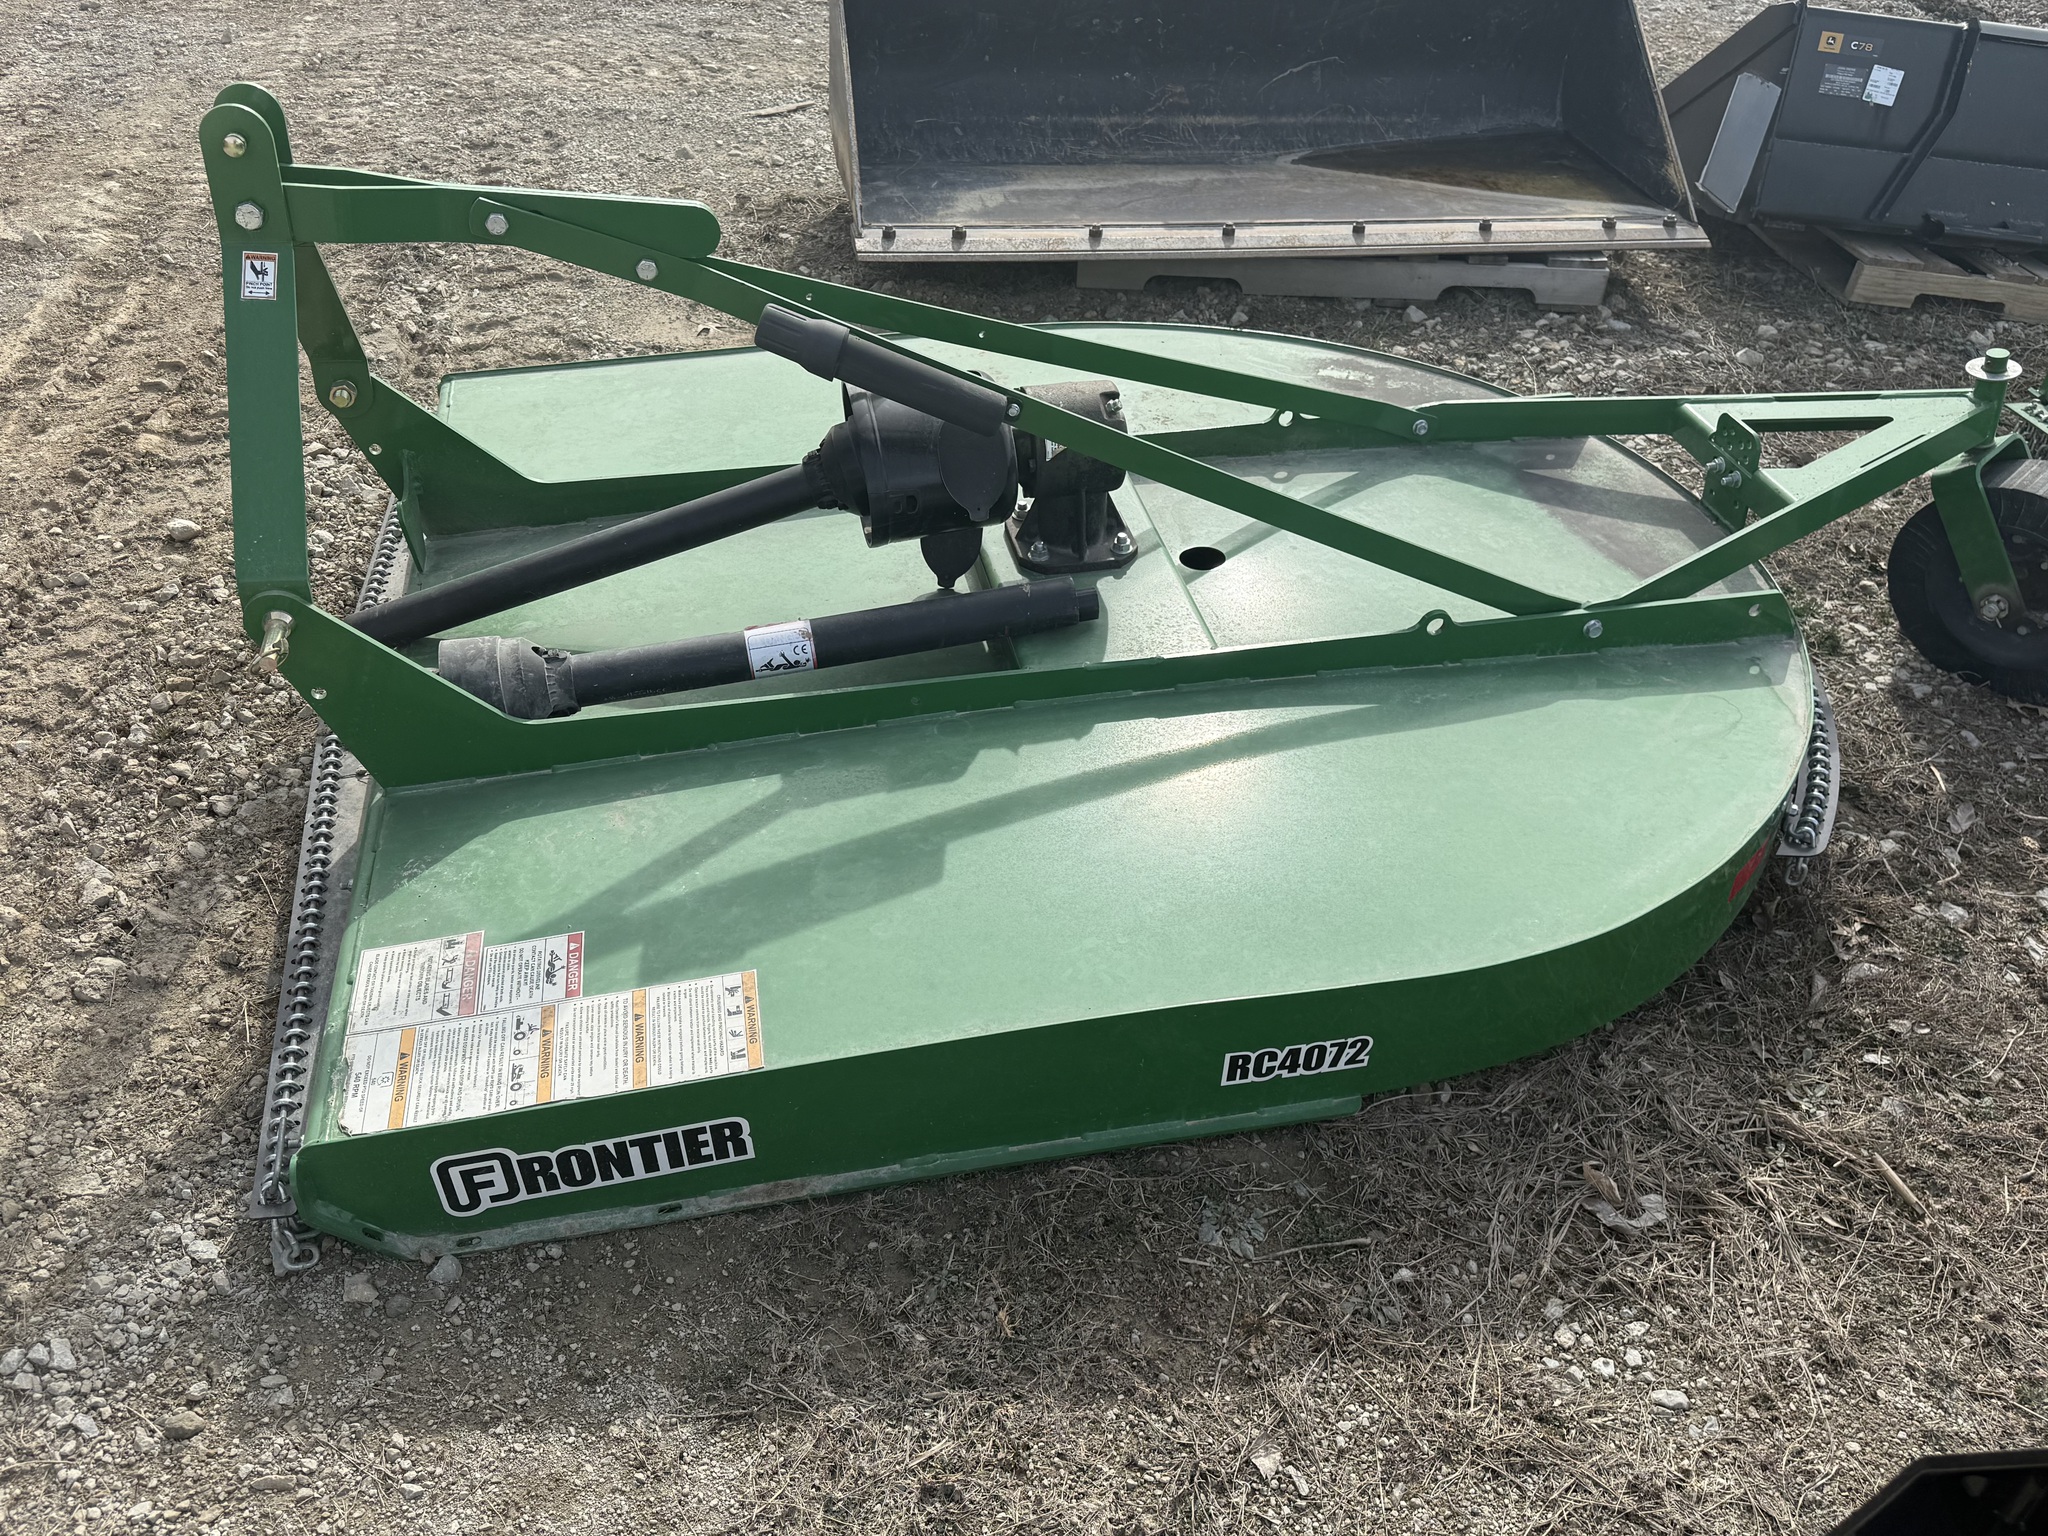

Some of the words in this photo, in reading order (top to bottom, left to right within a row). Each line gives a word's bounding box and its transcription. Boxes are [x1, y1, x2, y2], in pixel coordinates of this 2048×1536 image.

[1850, 41, 1874, 52] C78
[461, 959, 476, 1000] DANGER
[567, 951, 578, 990] DANGER
[634, 1022, 643, 1063] WARNING
[746, 1004, 757, 1044] WARNING
[353, 1071, 361, 1082] 540
[540, 1038, 550, 1079] WARNING
[622, 1058, 628, 1066] OR
[1224, 1036, 1372, 1083] RC4072
[350, 1083, 359, 1098] RPM
[393, 1061, 408, 1102] WARNING
[434, 1119, 752, 1214] FRONTIER
